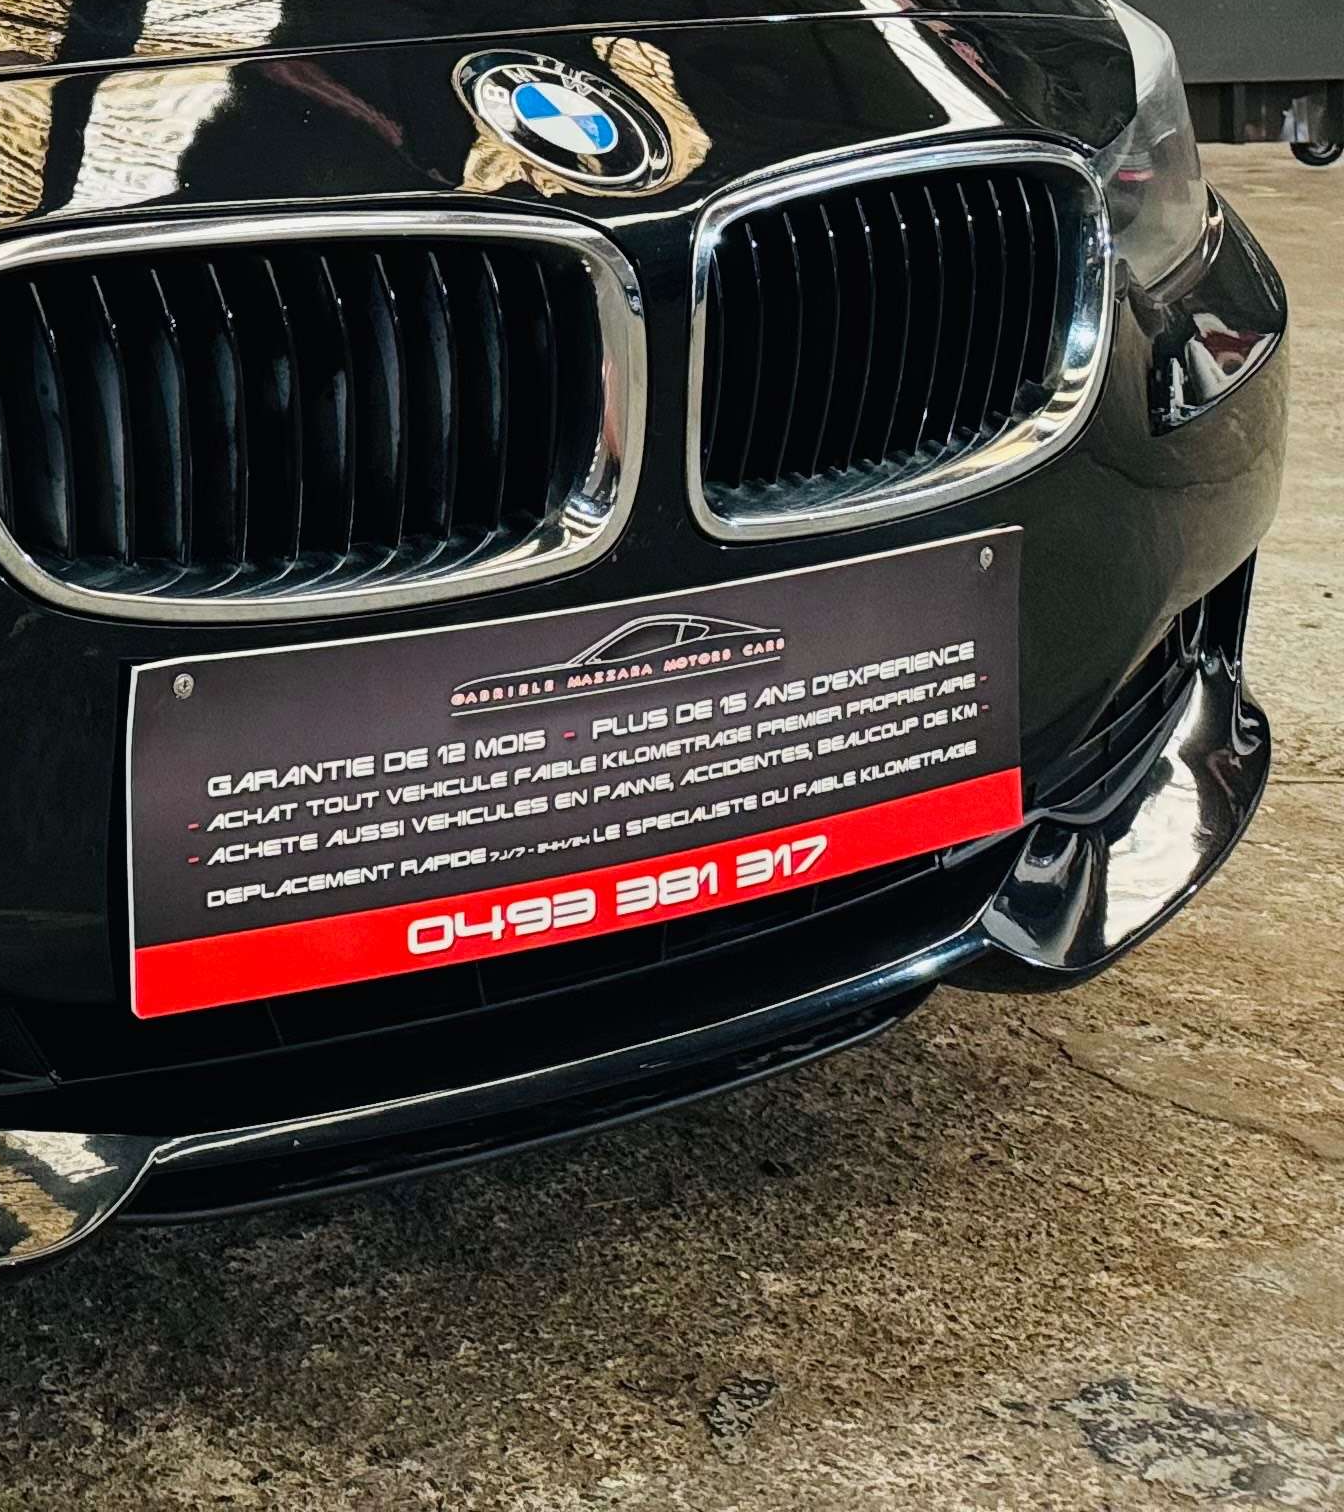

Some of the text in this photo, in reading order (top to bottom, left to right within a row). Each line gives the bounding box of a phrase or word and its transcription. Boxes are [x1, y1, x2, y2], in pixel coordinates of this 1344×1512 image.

[207, 755, 375, 798] GARANTIE
[383, 747, 429, 774] DE
[436, 742, 466, 765] 12
[474, 729, 546, 760] MOIS
[592, 707, 668, 740] PLUS
[675, 699, 712, 724] DE
[719, 692, 747, 715] 15
[753, 679, 806, 709] ANS
[812, 640, 975, 696] D'EXPERIENCE
[450, 638, 785, 706] GABRIELE MAZZARA MOTORS CARS
[206, 802, 299, 832] ACHAT
[306, 790, 380, 817] TOUT
[386, 770, 508, 804] VEHICULE
[514, 755, 597, 785] FAIBLE
[602, 725, 752, 769] KILOMETRAGE
[757, 705, 842, 739] PREMIER
[846, 673, 976, 718] PROPRIETAIRE
[206, 832, 318, 866] ACHETE
[324, 820, 405, 848] AUSSI
[411, 796, 549, 834] VEHICULES
[554, 790, 588, 810] EN
[593, 773, 675, 804] PANNE,
[679, 743, 813, 786] ACCIDENTES,
[817, 716, 919, 755] BEAUCOUP
[923, 708, 949, 730] DE
[951, 702, 978, 723] KM
[206, 862, 395, 908] DEPLACEMENT
[399, 847, 487, 878] RAPIDE
[593, 823, 621, 843] LE
[625, 794, 758, 837] SPECIALISTE
[793, 770, 857, 800] FAIBLE
[859, 740, 977, 783] KILOMETRAGE
[407, 834, 828, 955] 0493 381 317
